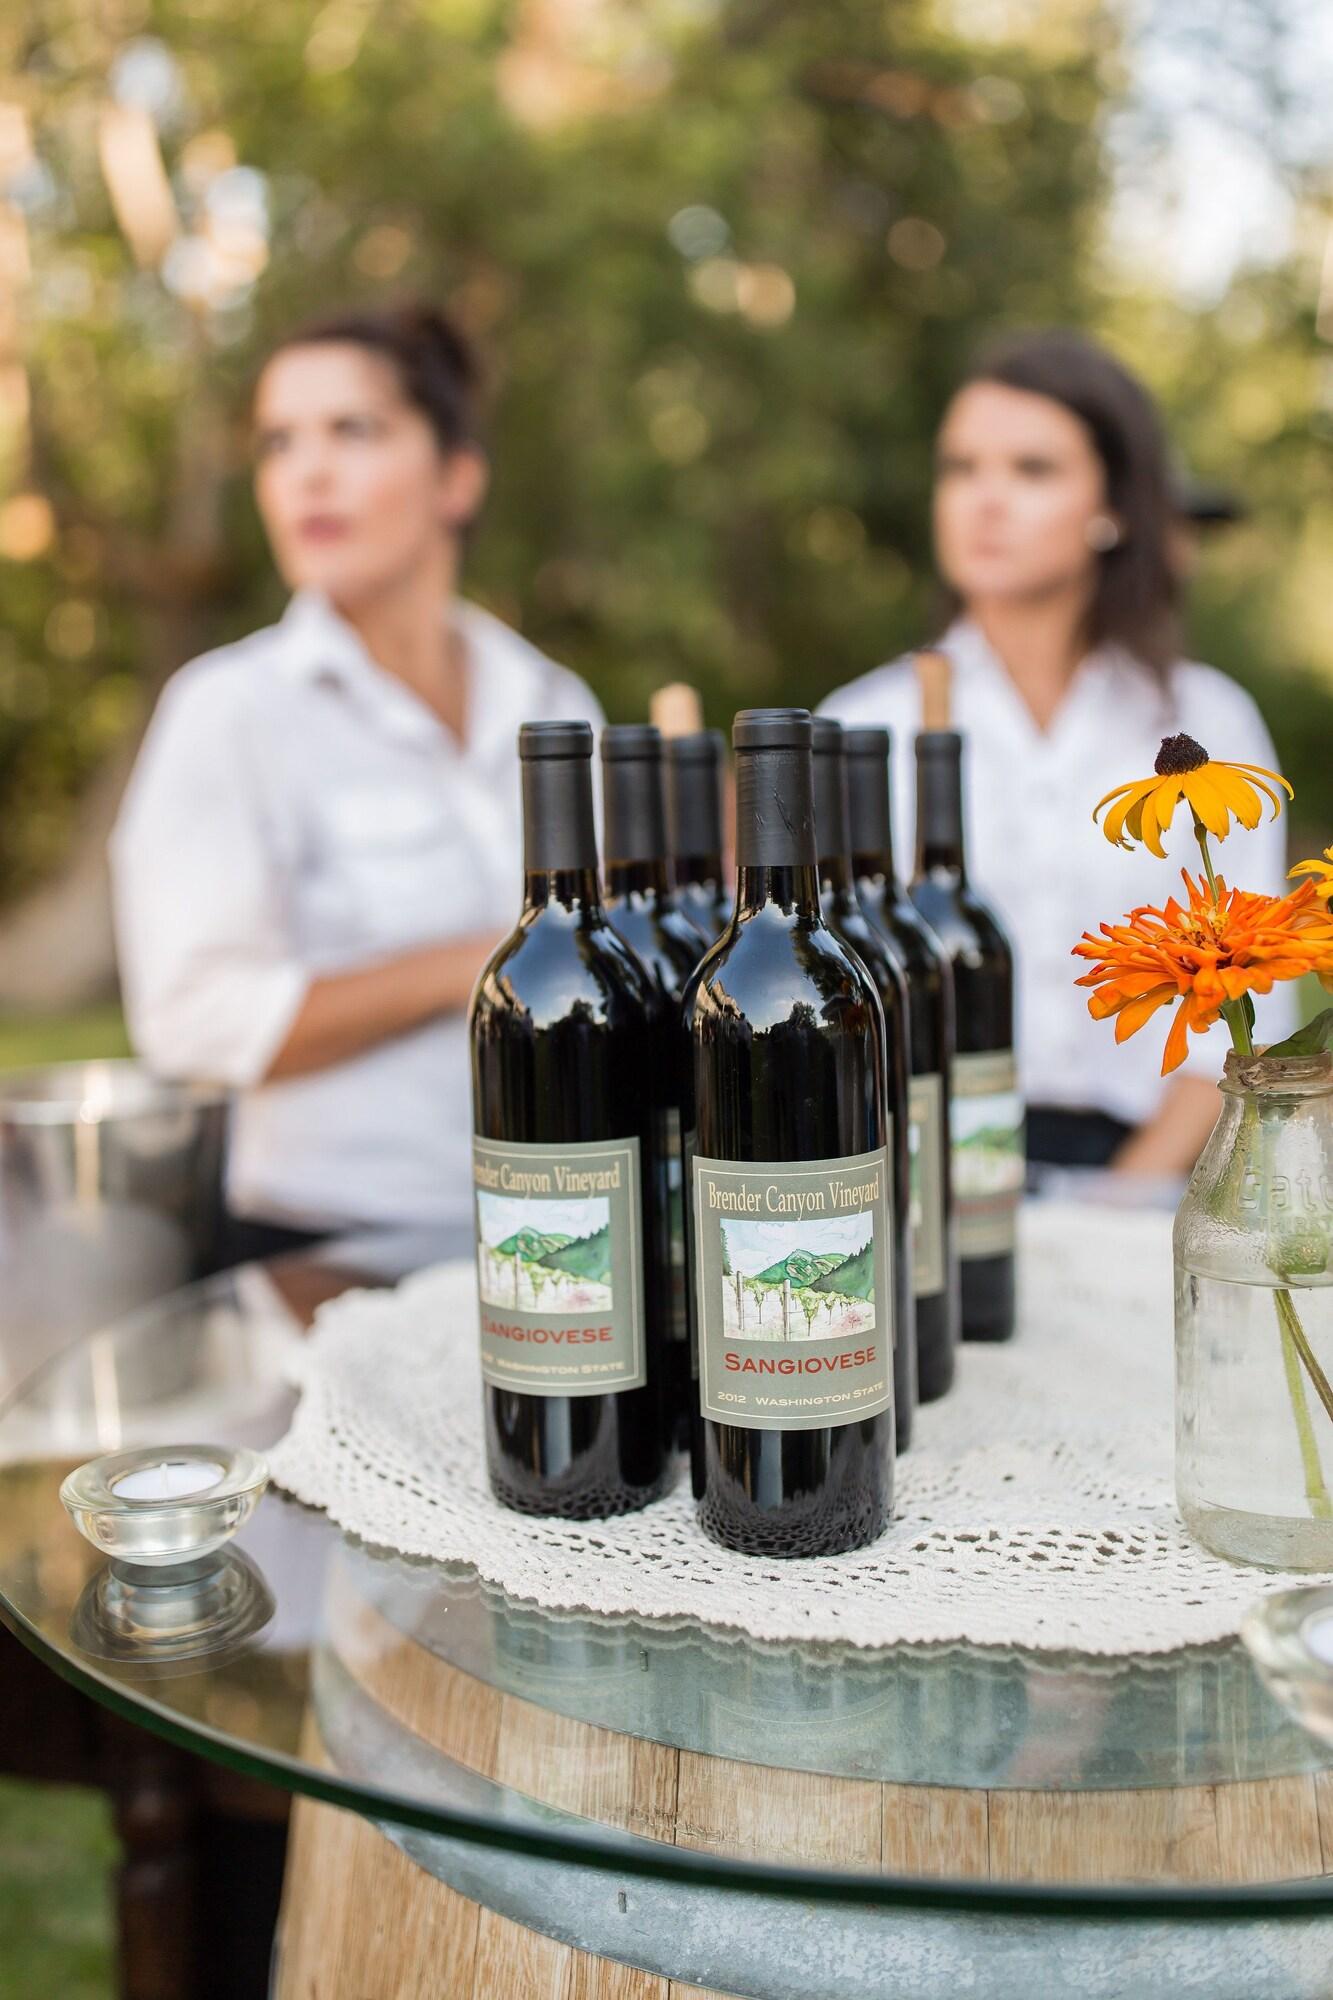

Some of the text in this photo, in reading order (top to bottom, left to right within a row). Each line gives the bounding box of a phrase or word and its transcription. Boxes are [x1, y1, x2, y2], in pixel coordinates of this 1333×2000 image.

[500, 1163, 551, 1200] Canyon
[553, 1161, 620, 1200] Vineyard
[706, 1172, 879, 1221] Brender Canyon Vineyard
[581, 1361, 624, 1375] STATE
[724, 1346, 876, 1375] SANGIOVESE
[717, 1381, 883, 1406] 2012 WASHINGTON STATE
